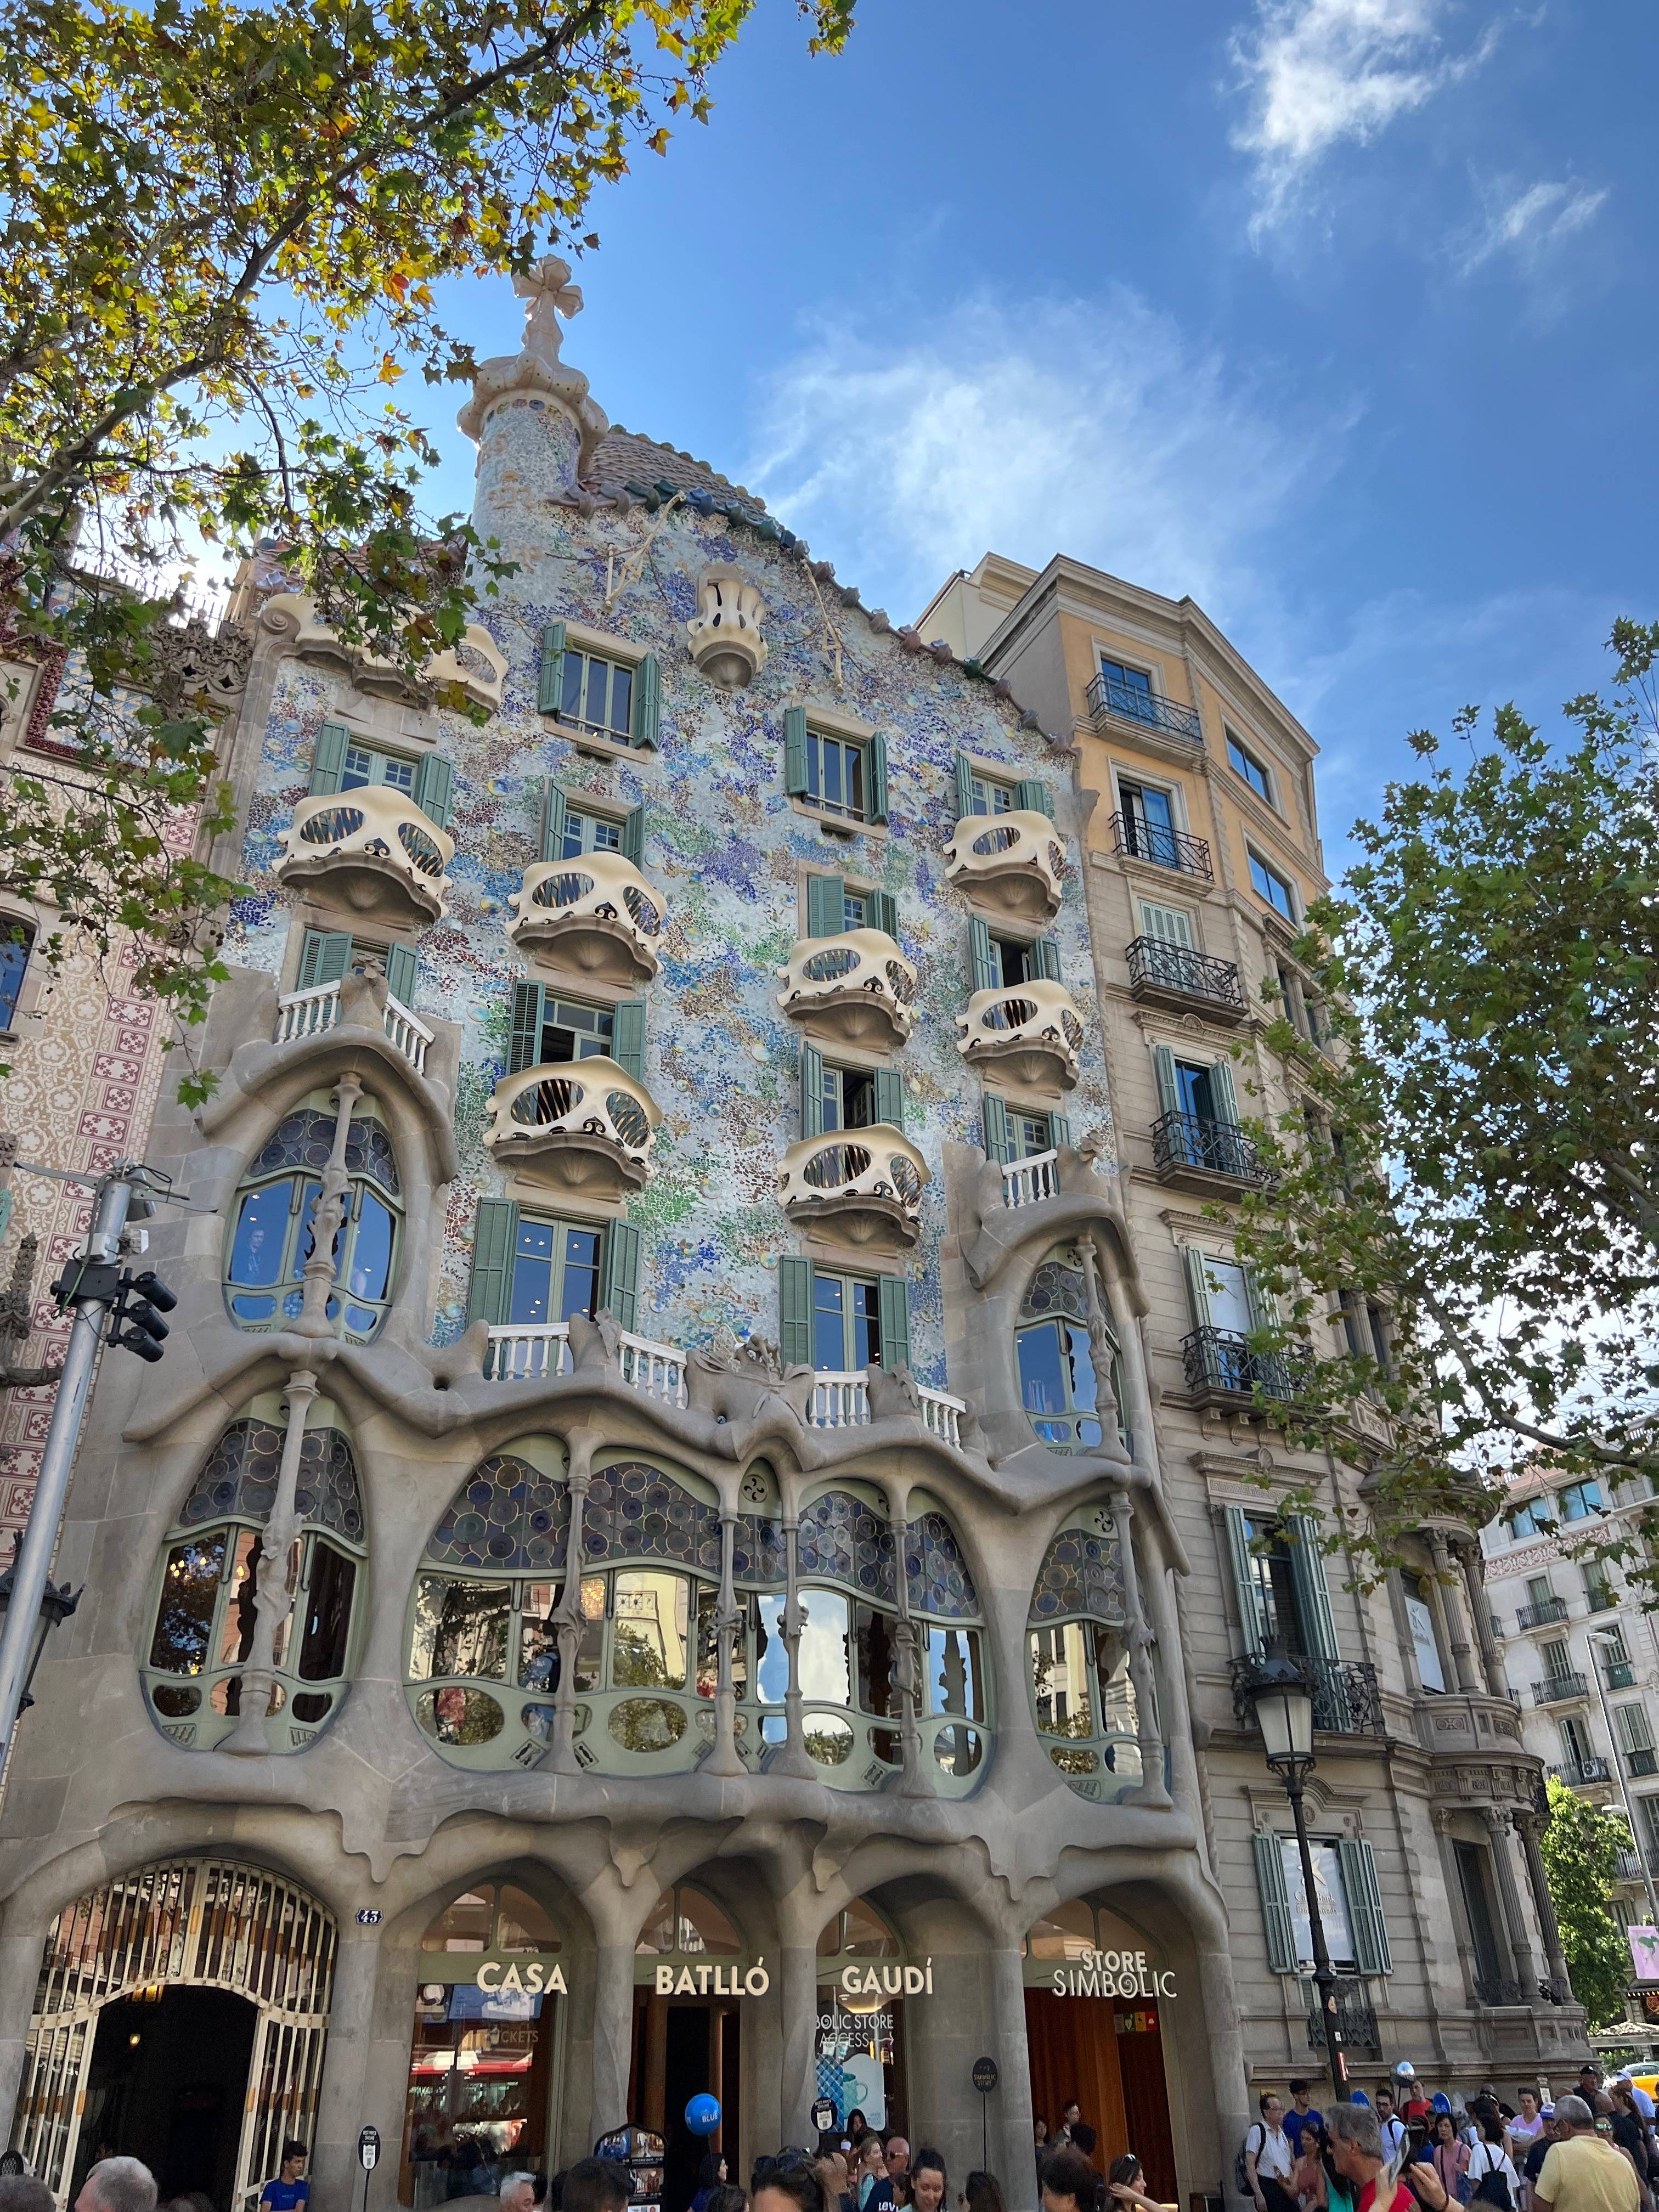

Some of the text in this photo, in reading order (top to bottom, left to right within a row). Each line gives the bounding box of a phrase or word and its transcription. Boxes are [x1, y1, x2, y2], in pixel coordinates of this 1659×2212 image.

[360, 1910, 379, 1923] 43
[1080, 1950, 1148, 1972] STORE
[477, 1956, 933, 1996] CASA BATLLÓ GAUDÍ
[1052, 1969, 1177, 1999] SIMBOLIC
[854, 2015, 894, 2029] STORE
[819, 2032, 869, 2047] ACCESS
[702, 2111, 718, 2123] BLUE
